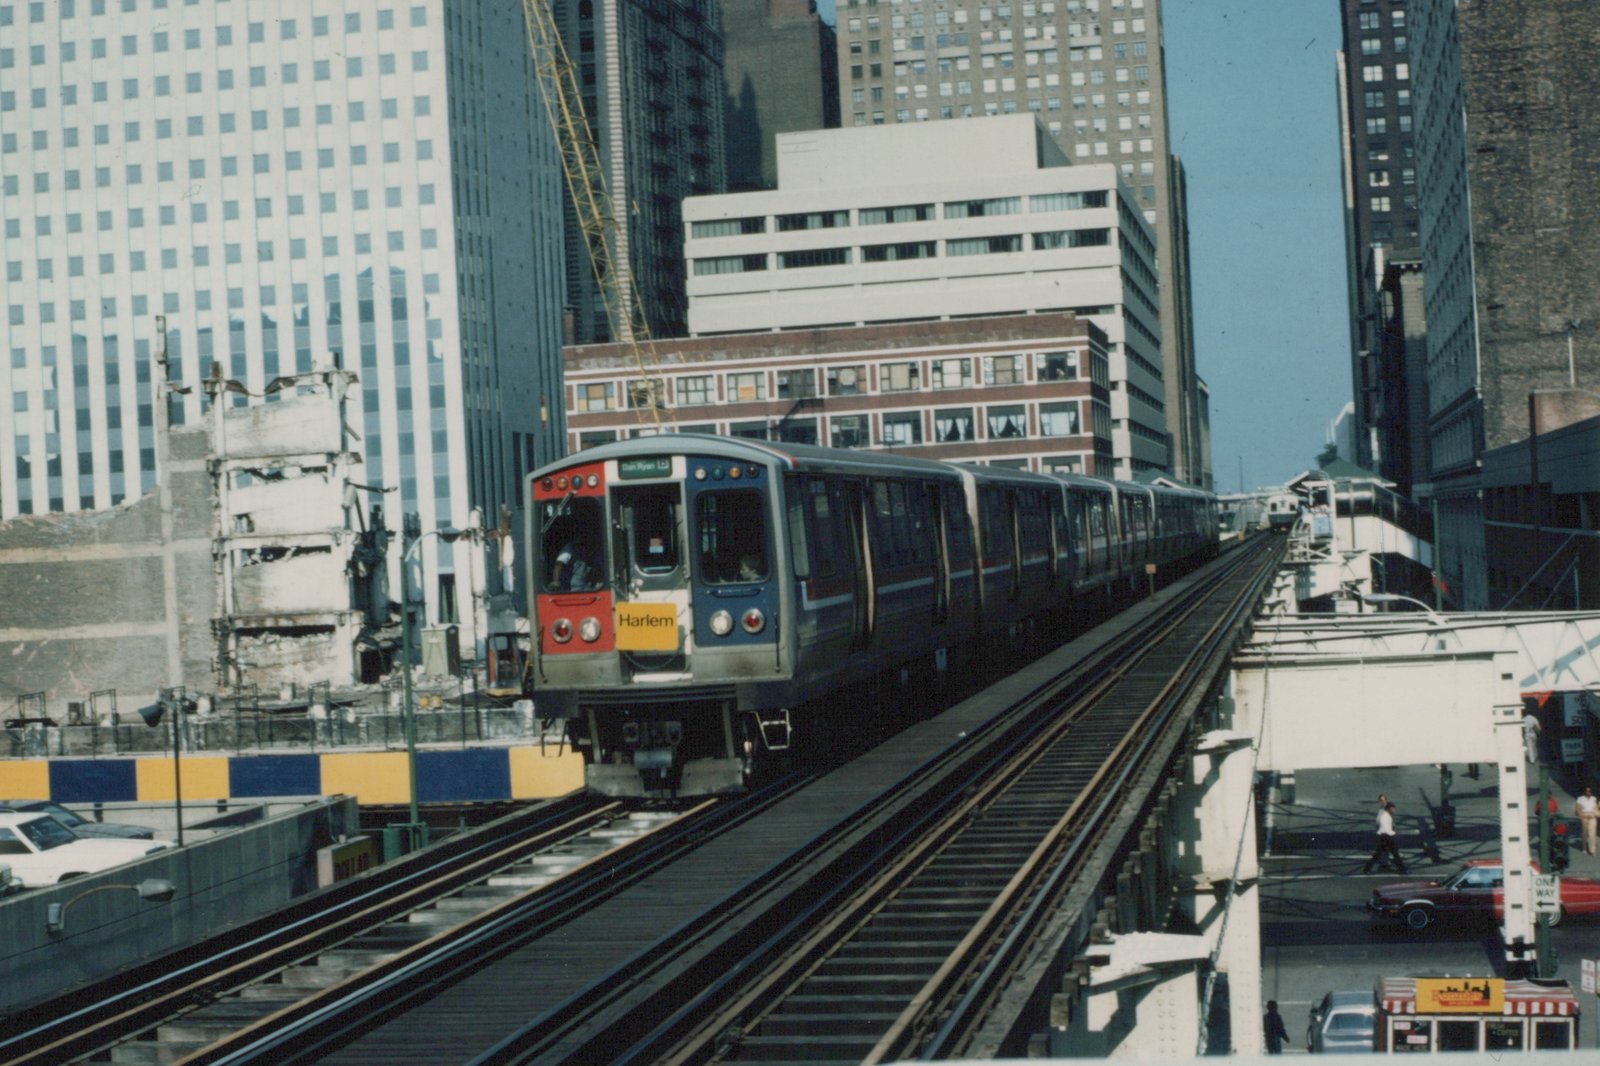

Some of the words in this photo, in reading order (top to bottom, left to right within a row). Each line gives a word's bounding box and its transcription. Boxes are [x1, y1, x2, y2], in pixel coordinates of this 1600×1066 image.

[619, 613, 674, 627] Harlem
[1536, 877, 1555, 887] ONE
[1536, 888, 1555, 898] WAY
